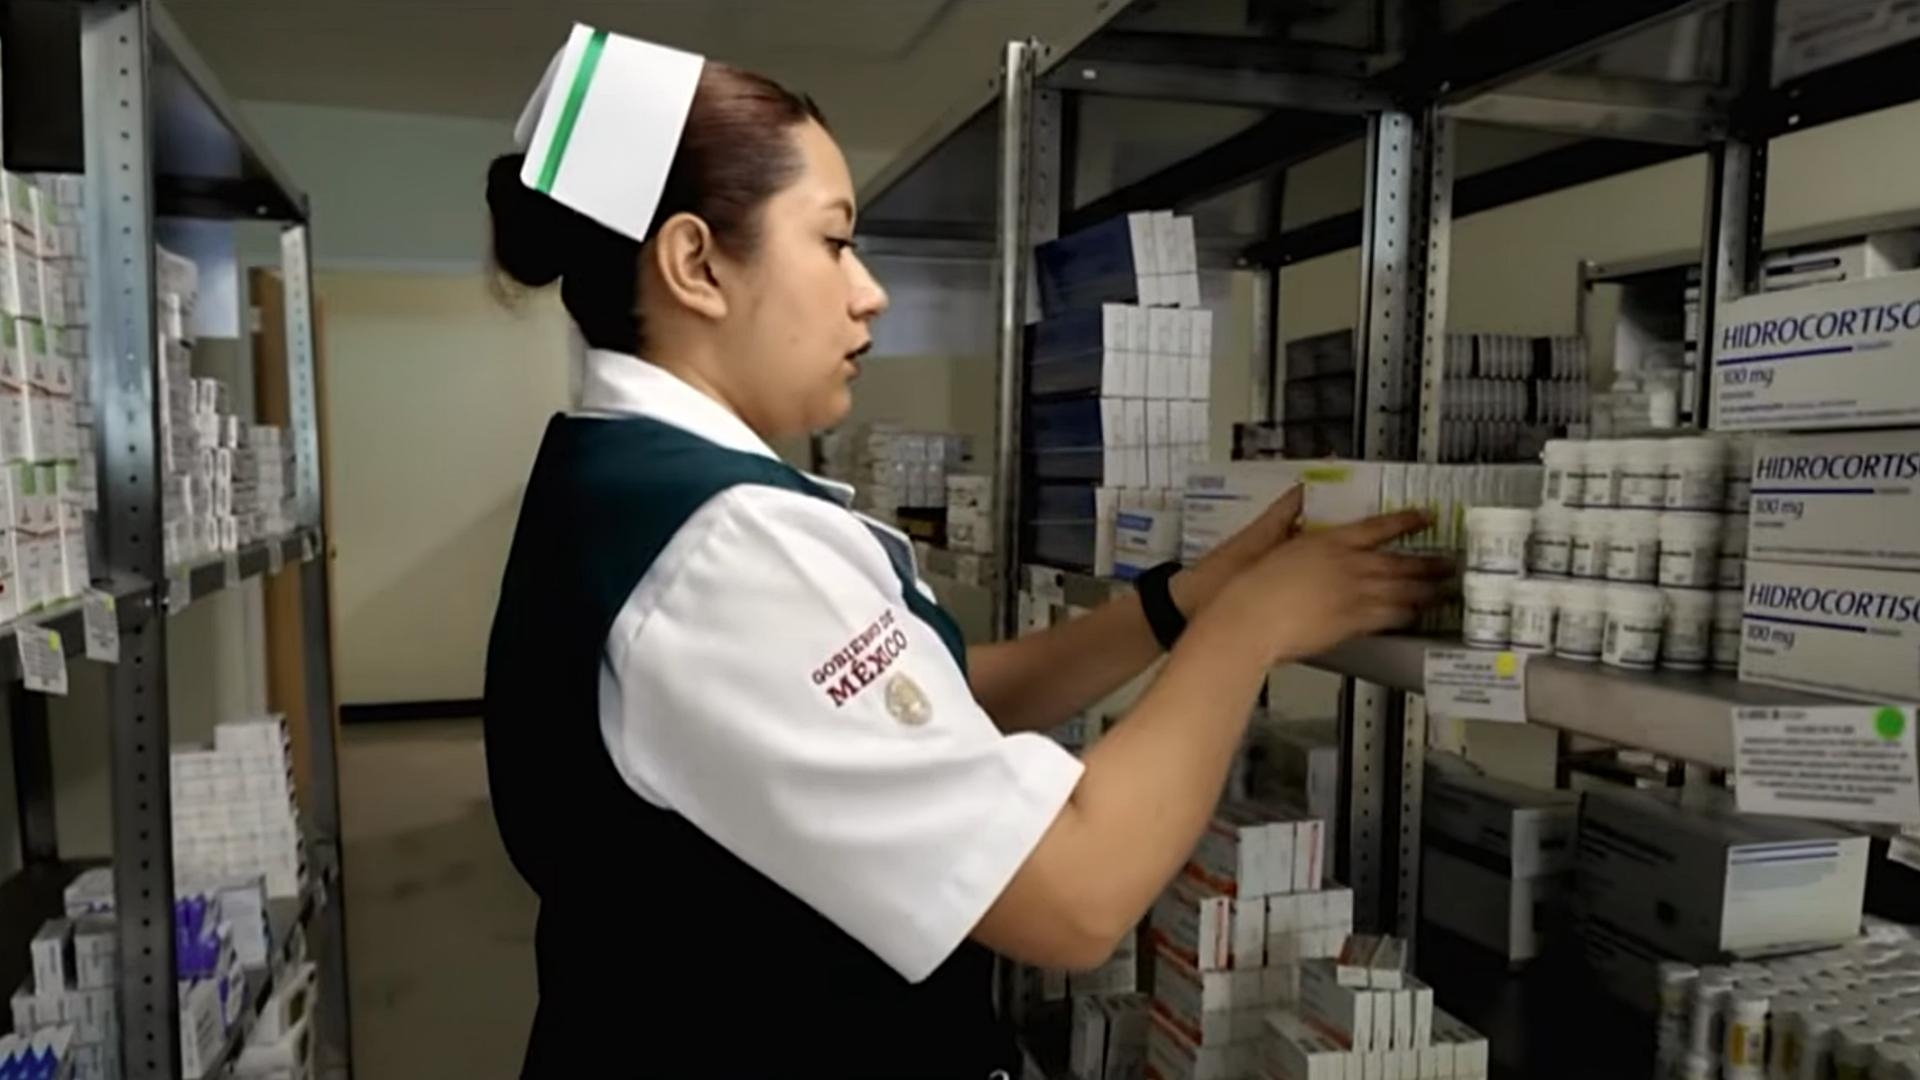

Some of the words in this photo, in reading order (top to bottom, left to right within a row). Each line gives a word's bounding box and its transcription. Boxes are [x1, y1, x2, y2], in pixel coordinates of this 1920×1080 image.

[1722, 299, 1920, 349] HIDROCORTISO
[1723, 369, 1747, 385] 100
[1750, 368, 1774, 387] mg
[1756, 452, 1920, 480] HIDROCORTIS
[1756, 499, 1779, 515] 100
[1780, 501, 1805, 519] mg
[1748, 625, 1770, 641] 100
[1771, 629, 1795, 650] mg
[811, 622, 881, 685] GOBIERNO
[826, 629, 908, 707] MÉXICO
